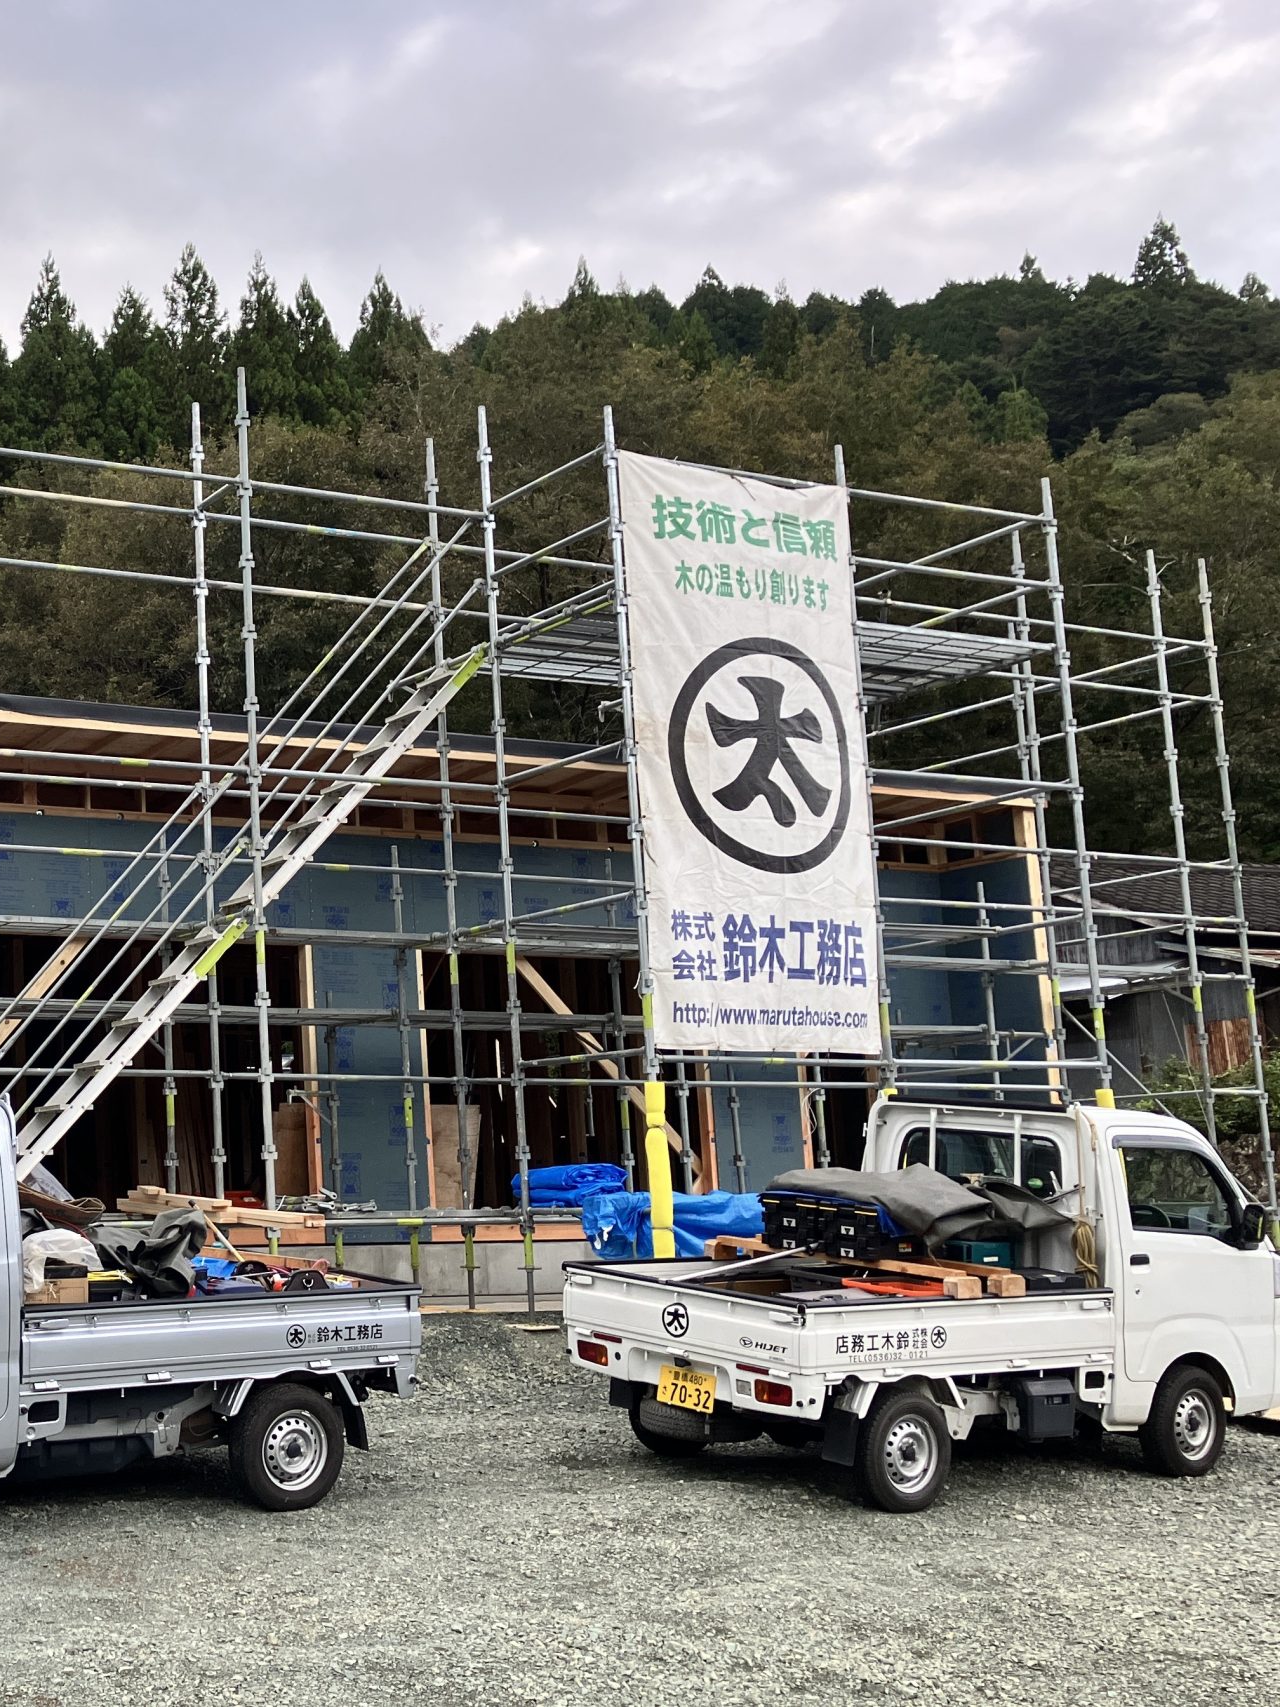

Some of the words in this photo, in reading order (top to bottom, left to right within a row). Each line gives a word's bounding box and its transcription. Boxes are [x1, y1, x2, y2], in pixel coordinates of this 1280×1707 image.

[651, 494, 838, 562] 技術と信頼
[675, 559, 829, 611] 木の温もり創ります
[722, 914, 867, 988] 鈴木工務店
[673, 1001, 868, 1029] http://www.marutahouse.com
[317, 1323, 383, 1342] 鈴木工務店
[755, 1342, 788, 1354] HIJET
[670, 1382, 711, 1410] 70-32
